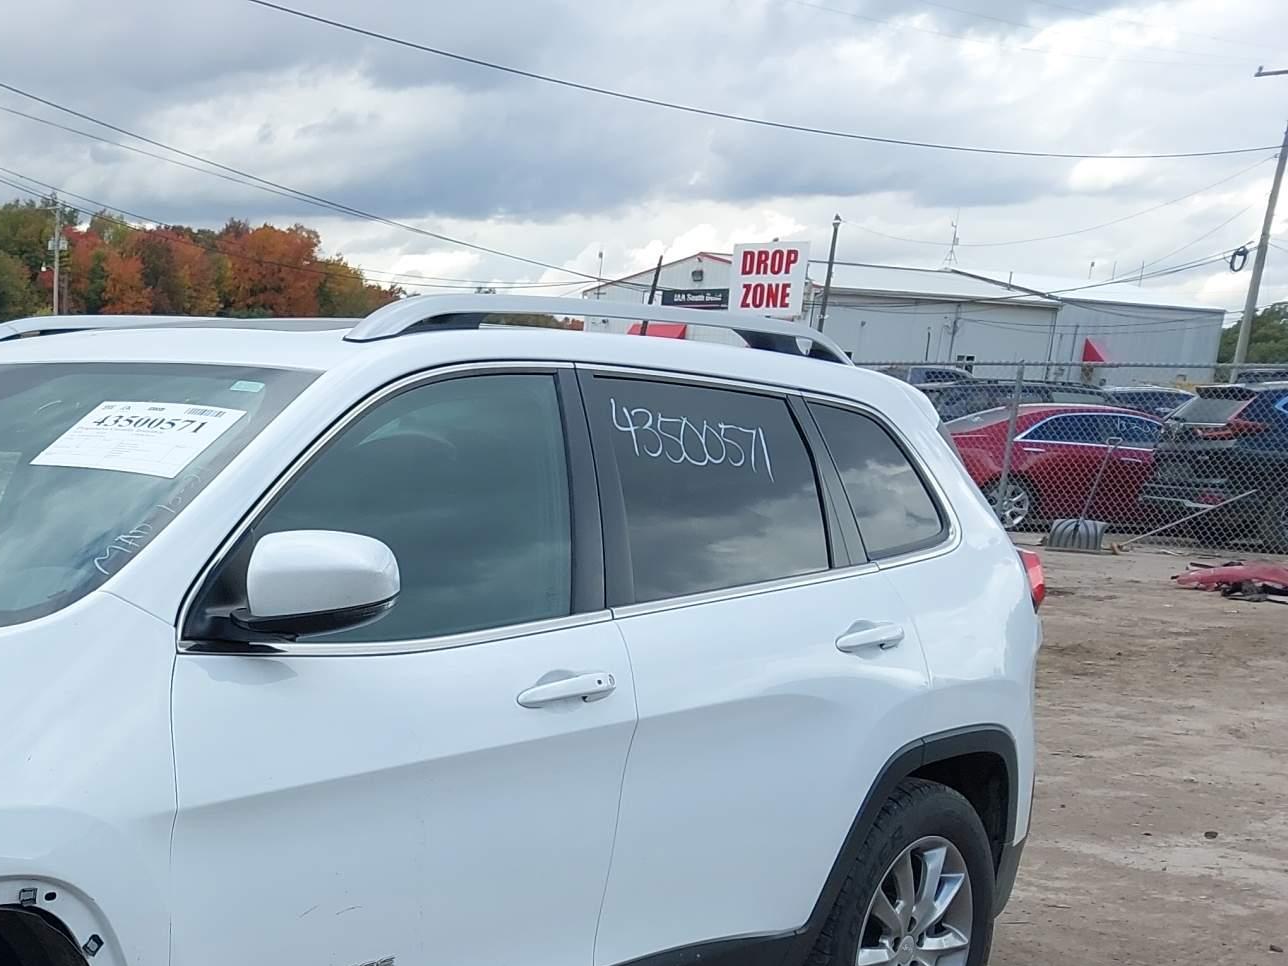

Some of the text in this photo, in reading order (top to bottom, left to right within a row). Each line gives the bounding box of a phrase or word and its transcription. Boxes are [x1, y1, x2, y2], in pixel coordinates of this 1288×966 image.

[741, 249, 799, 275] DROP
[740, 283, 792, 308] ZONE
[91, 414, 208, 434] 43500571
[610, 397, 775, 483] 43500571
